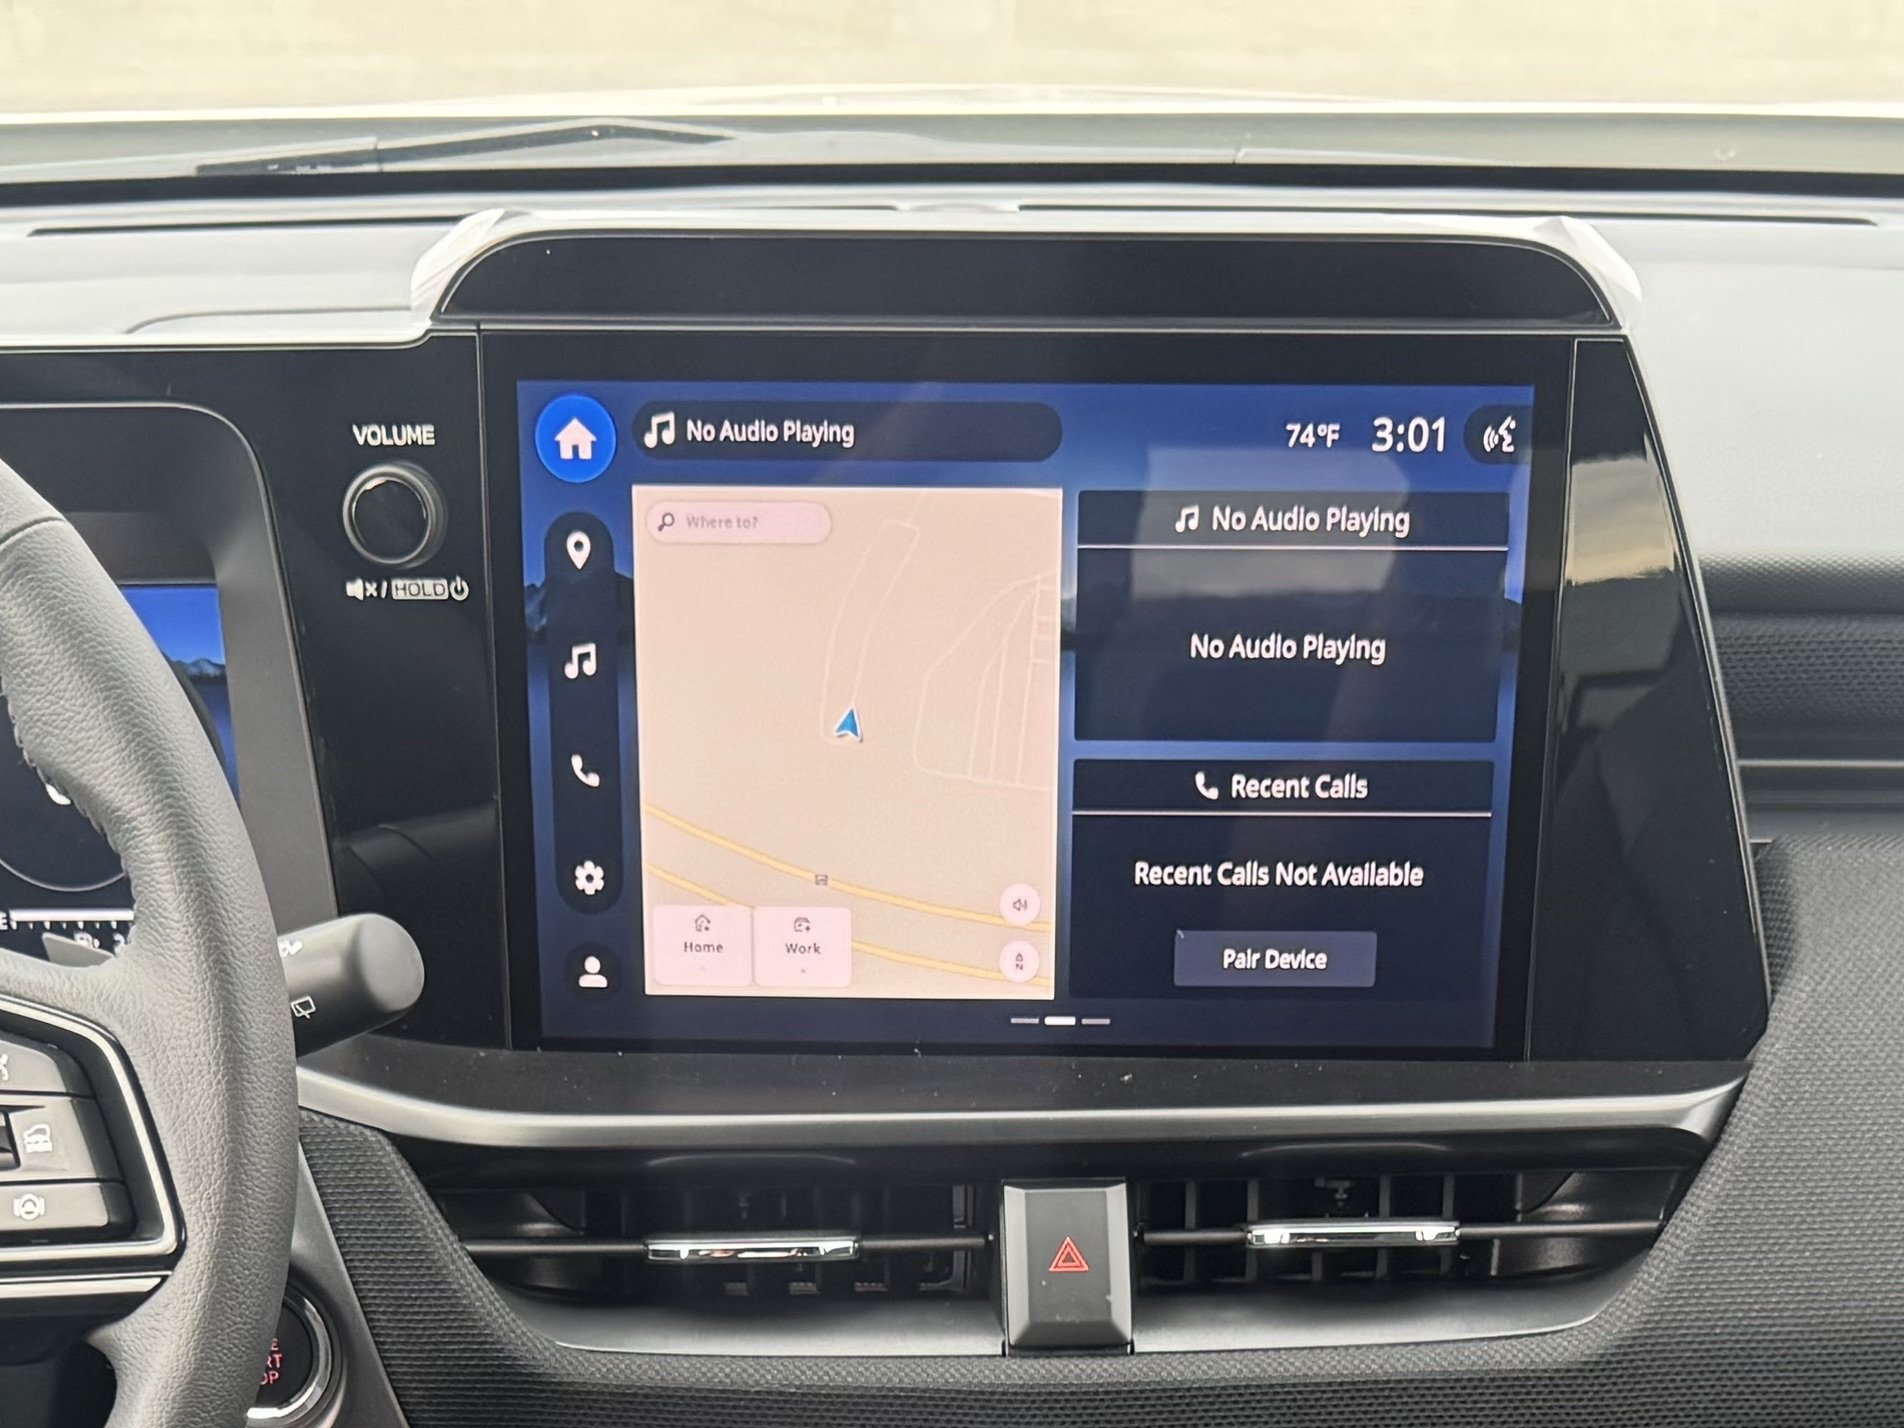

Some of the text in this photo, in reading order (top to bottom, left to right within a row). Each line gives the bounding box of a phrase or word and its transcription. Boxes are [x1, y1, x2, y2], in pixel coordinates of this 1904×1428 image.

[352, 424, 435, 446] VOLUME
[686, 420, 855, 449] No Audio Playing
[1371, 416, 1445, 453] 3:01
[686, 515, 759, 529] Where to?
[1211, 505, 1411, 538] No Audio Playing
[393, 580, 447, 599] HOLD
[1190, 633, 1386, 666] No Audio Playing
[1231, 773, 1368, 800] Recent Calls
[1134, 861, 1425, 887] Recent Calls Not Available
[683, 941, 724, 954] Home
[785, 941, 821, 955] Work
[1222, 948, 1328, 970] Pair Device
